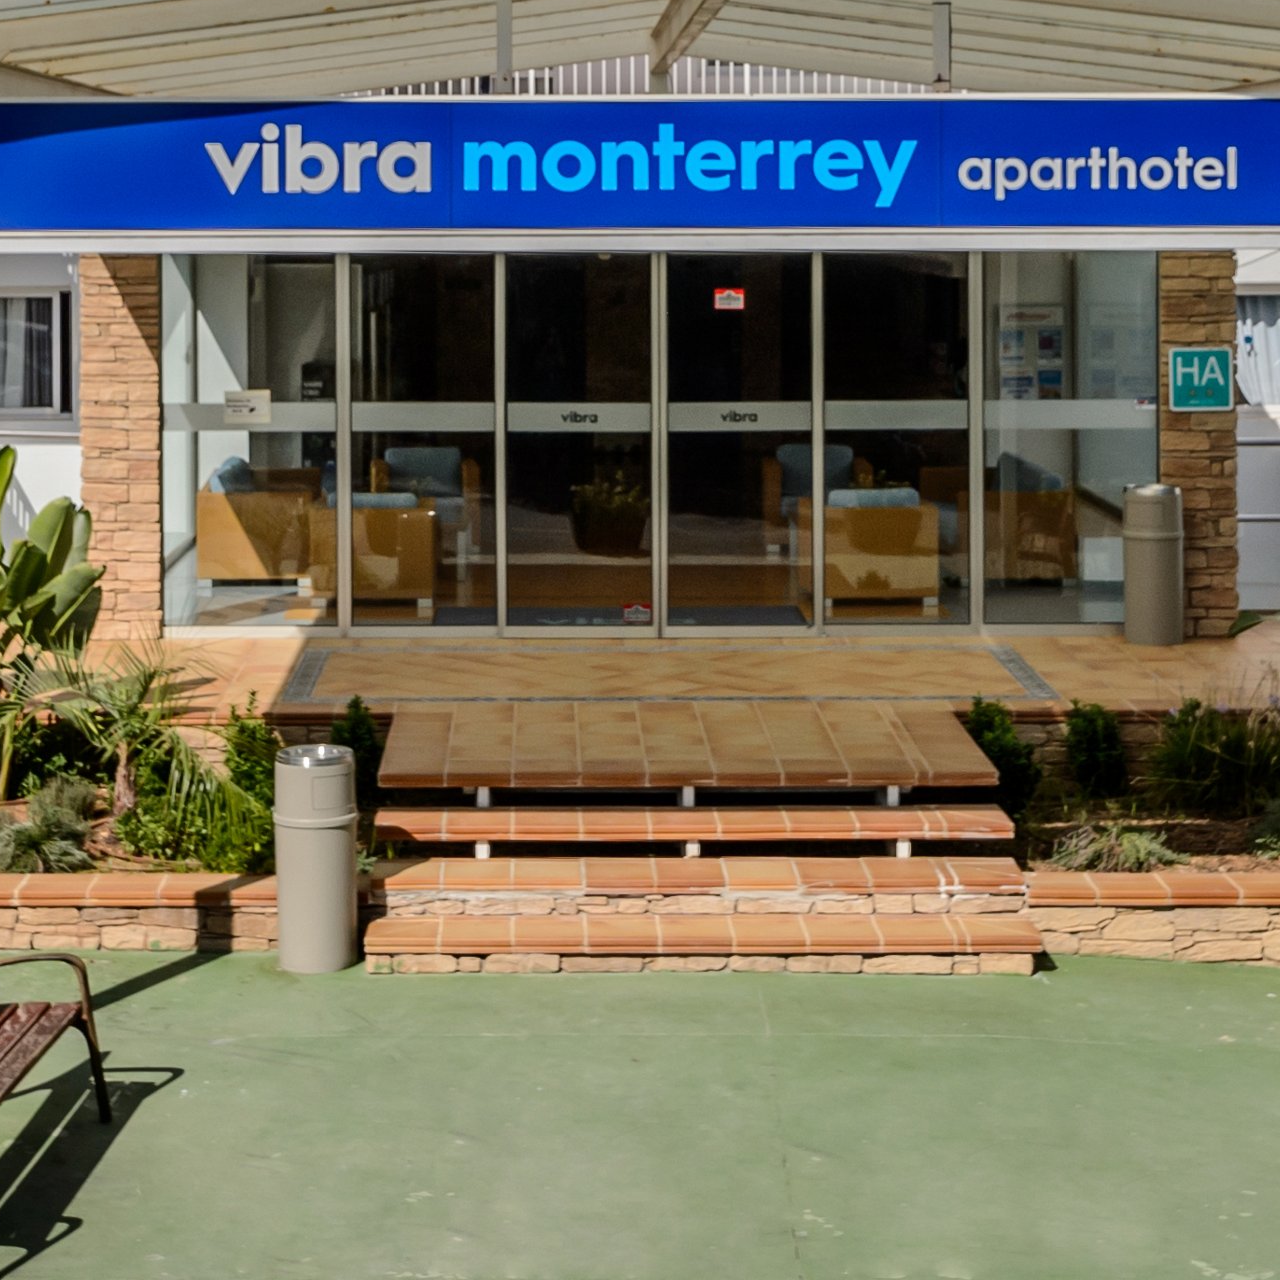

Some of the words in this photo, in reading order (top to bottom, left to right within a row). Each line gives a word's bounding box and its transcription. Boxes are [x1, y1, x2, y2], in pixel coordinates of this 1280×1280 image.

[204, 123, 432, 194] vibra
[463, 123, 917, 207] monterrey
[957, 146, 1238, 200] aparthotel
[1176, 355, 1225, 387] HA
[561, 411, 598, 424] vibra
[721, 410, 758, 423] vibra
